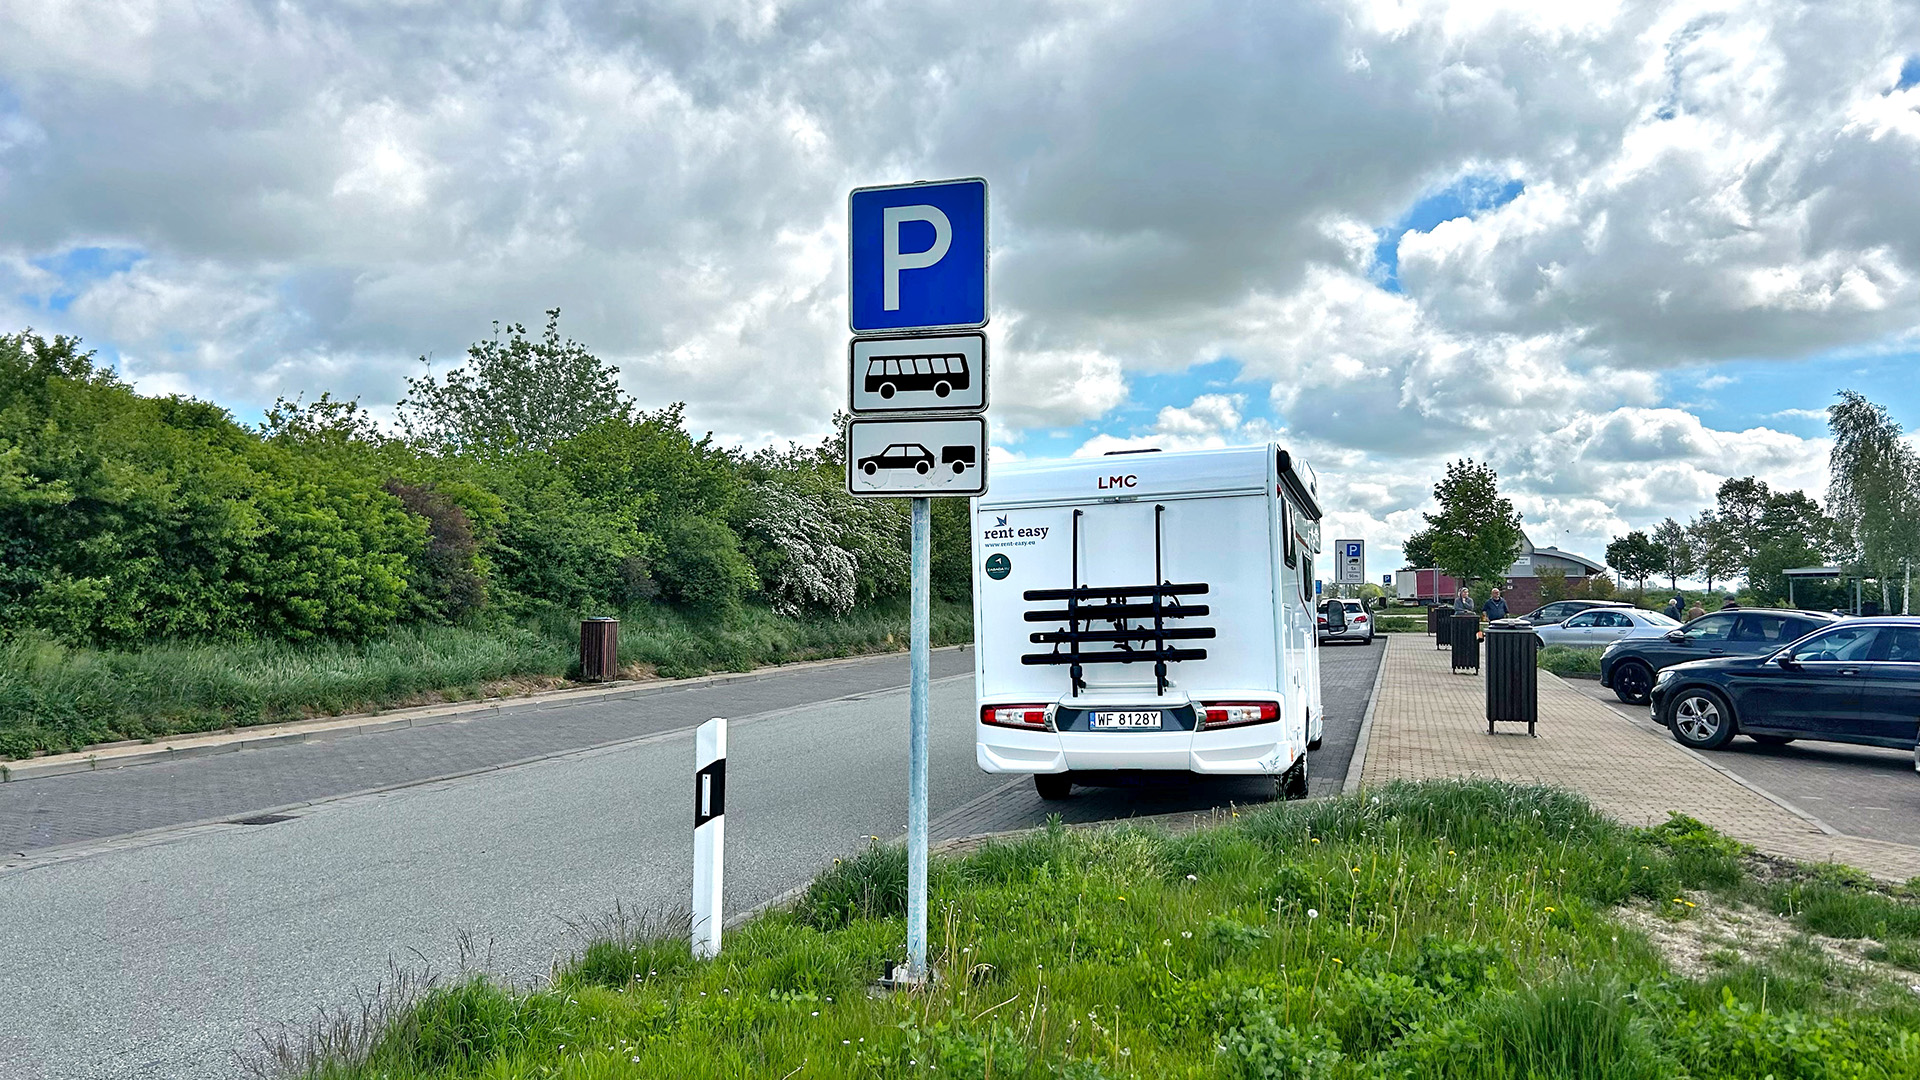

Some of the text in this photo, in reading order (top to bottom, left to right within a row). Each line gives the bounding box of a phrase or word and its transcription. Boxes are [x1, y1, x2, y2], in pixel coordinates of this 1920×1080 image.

[883, 204, 952, 311] P
[1098, 474, 1138, 490] LMC
[984, 526, 1050, 541] rent easy
[1349, 545, 1358, 556] P
[1097, 712, 1158, 726] WF 8128Y
